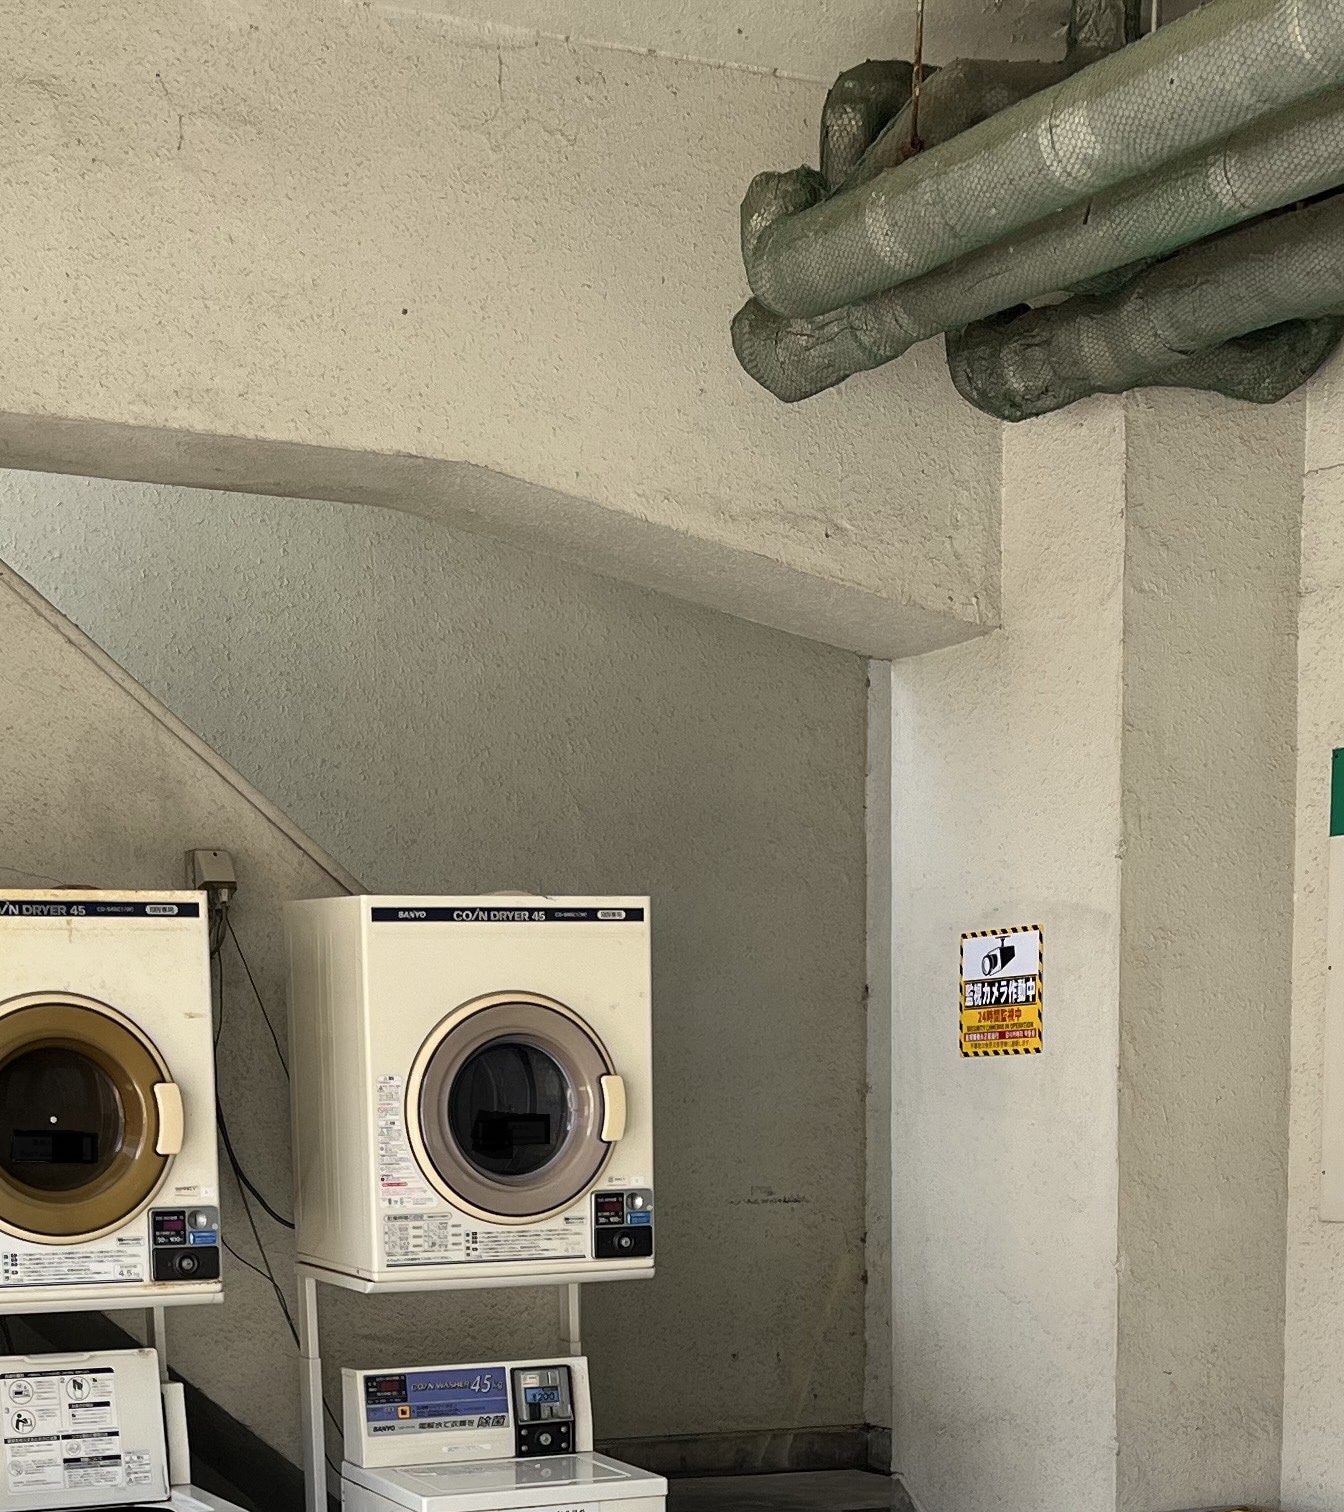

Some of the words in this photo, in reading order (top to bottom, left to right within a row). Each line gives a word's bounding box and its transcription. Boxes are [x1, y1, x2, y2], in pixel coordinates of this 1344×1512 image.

[22, 904, 67, 916] DRYER
[69, 905, 86, 916] 45
[398, 911, 426, 919] SANYO
[490, 911, 529, 921] DRYER
[531, 911, 546, 921] 45
[964, 977, 1036, 1007] 監視カメラ作動中
[436, 1381, 470, 1390] WASHER
